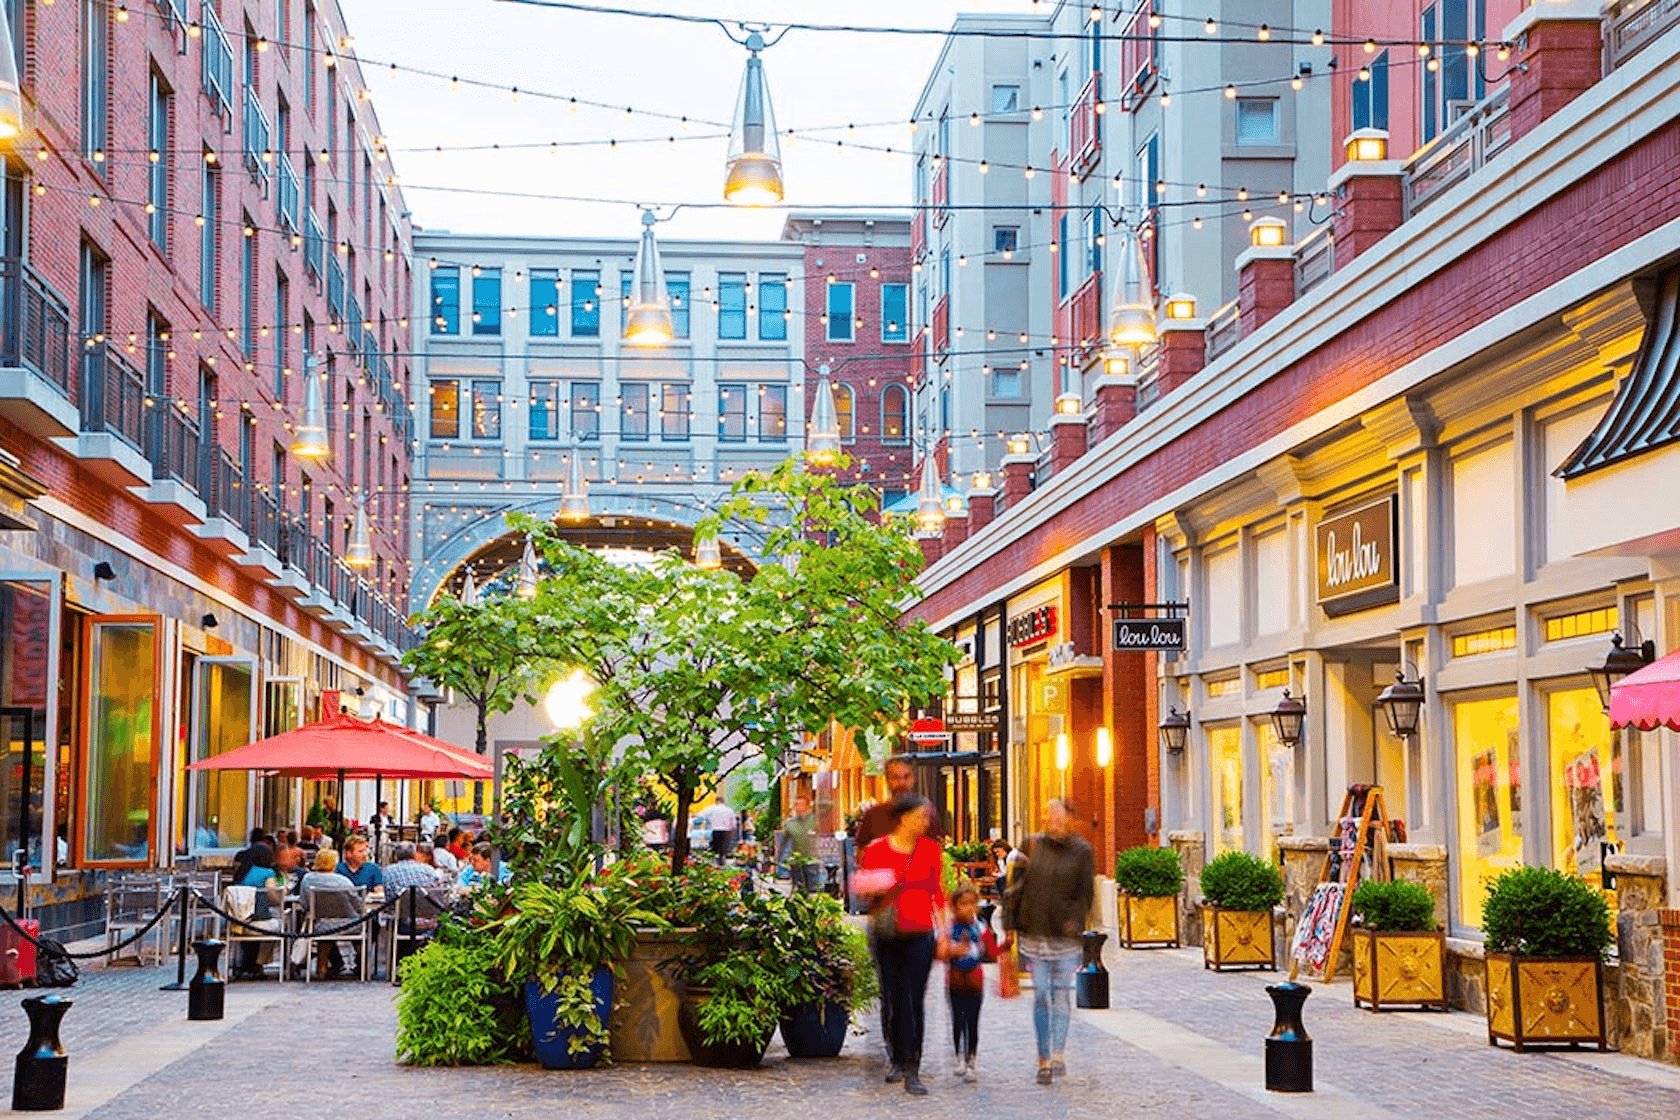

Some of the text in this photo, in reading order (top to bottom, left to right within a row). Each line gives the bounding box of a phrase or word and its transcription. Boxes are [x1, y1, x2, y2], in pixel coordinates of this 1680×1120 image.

[1326, 521, 1381, 588] lou lou
[1119, 625, 1181, 646] lou lou
[1043, 685, 1058, 708] P
[946, 715, 1000, 725] BUBBLES
